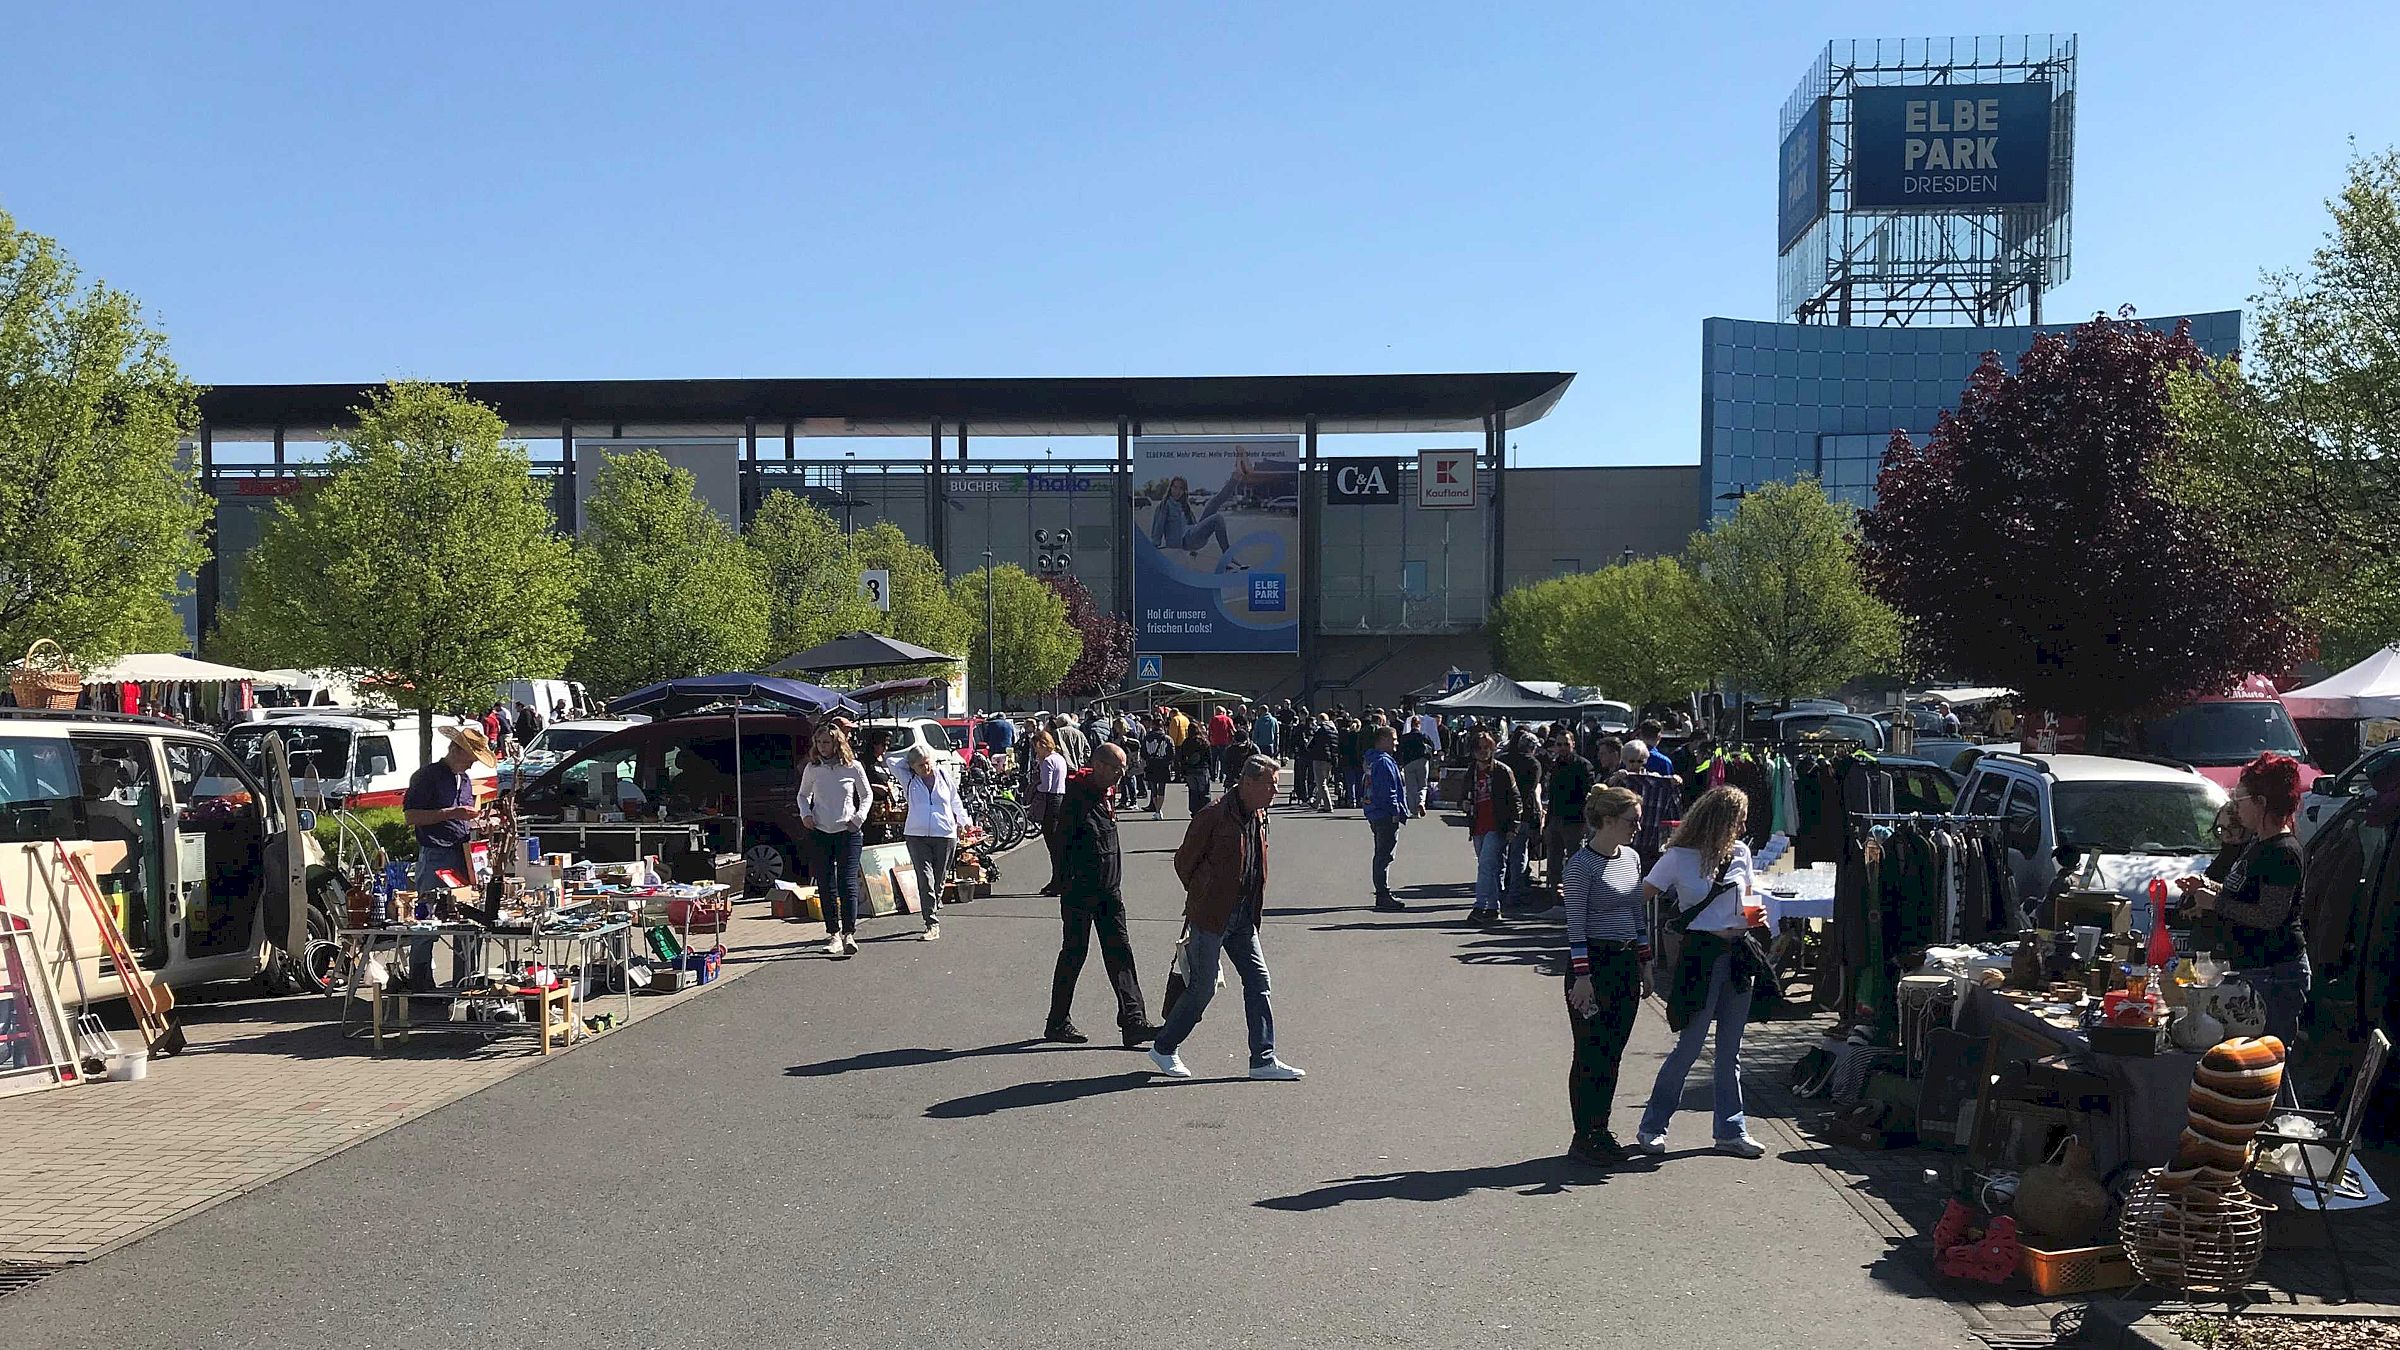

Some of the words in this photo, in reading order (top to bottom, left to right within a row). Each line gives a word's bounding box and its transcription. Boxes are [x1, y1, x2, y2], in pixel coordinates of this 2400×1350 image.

[1905, 99, 1999, 133] ELBE
[1904, 136, 1999, 171] PARK
[1904, 175, 1998, 194] DRESDEN
[1336, 466, 1390, 495] C&A
[1425, 488, 1469, 498] Kaufland
[866, 579, 880, 603] 3
[1255, 580, 1279, 590] ELBE
[1255, 590, 1279, 599] PARK
[1147, 608, 1161, 620] Hol
[1163, 608, 1175, 620] dir
[1176, 609, 1207, 620] unsere
[1147, 622, 1182, 634] frischen
[1184, 622, 1213, 634] Looks!
